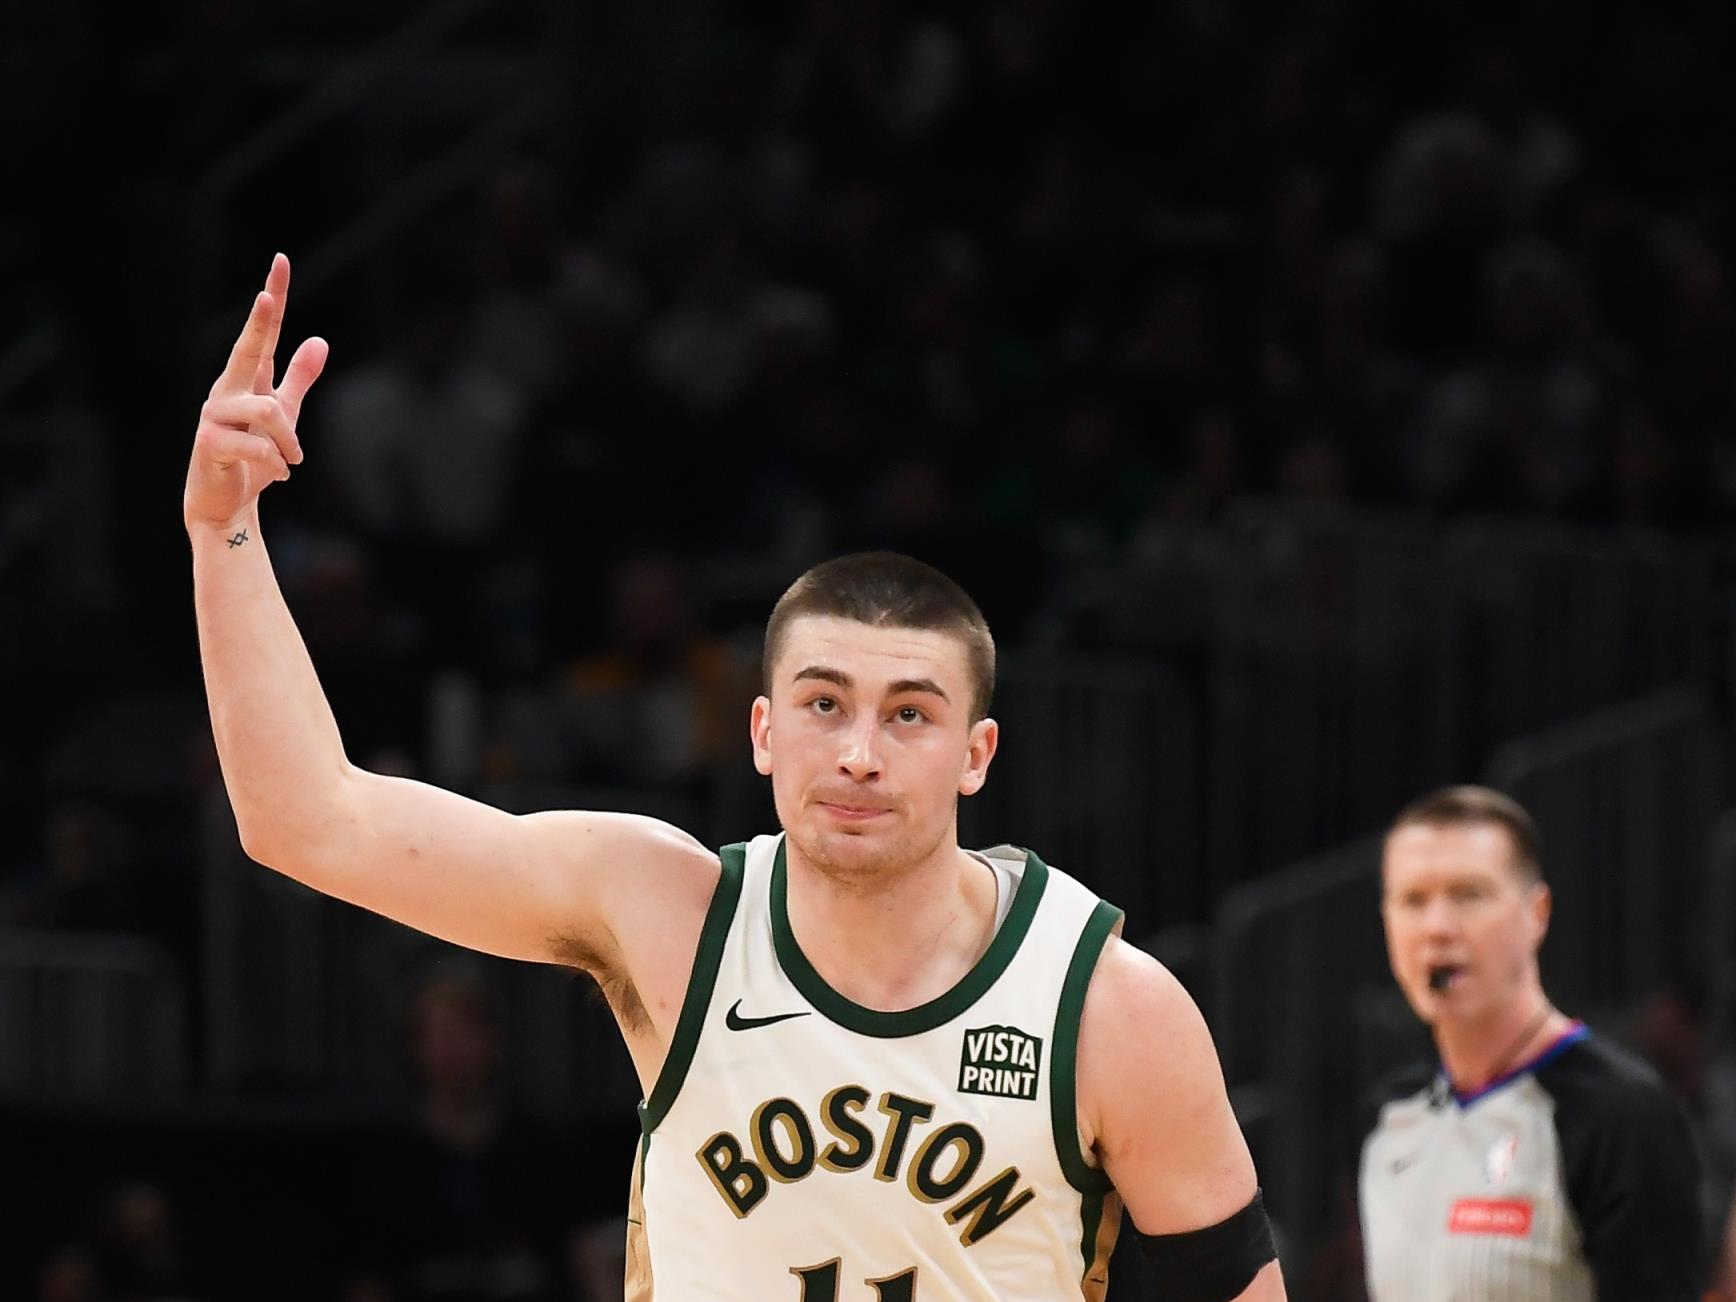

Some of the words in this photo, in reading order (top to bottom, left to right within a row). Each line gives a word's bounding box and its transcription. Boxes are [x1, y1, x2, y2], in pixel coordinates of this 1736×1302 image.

[967, 1032, 1036, 1071] VISTA
[962, 1065, 1036, 1096] PRINT
[696, 1084, 1035, 1247] BOSTON
